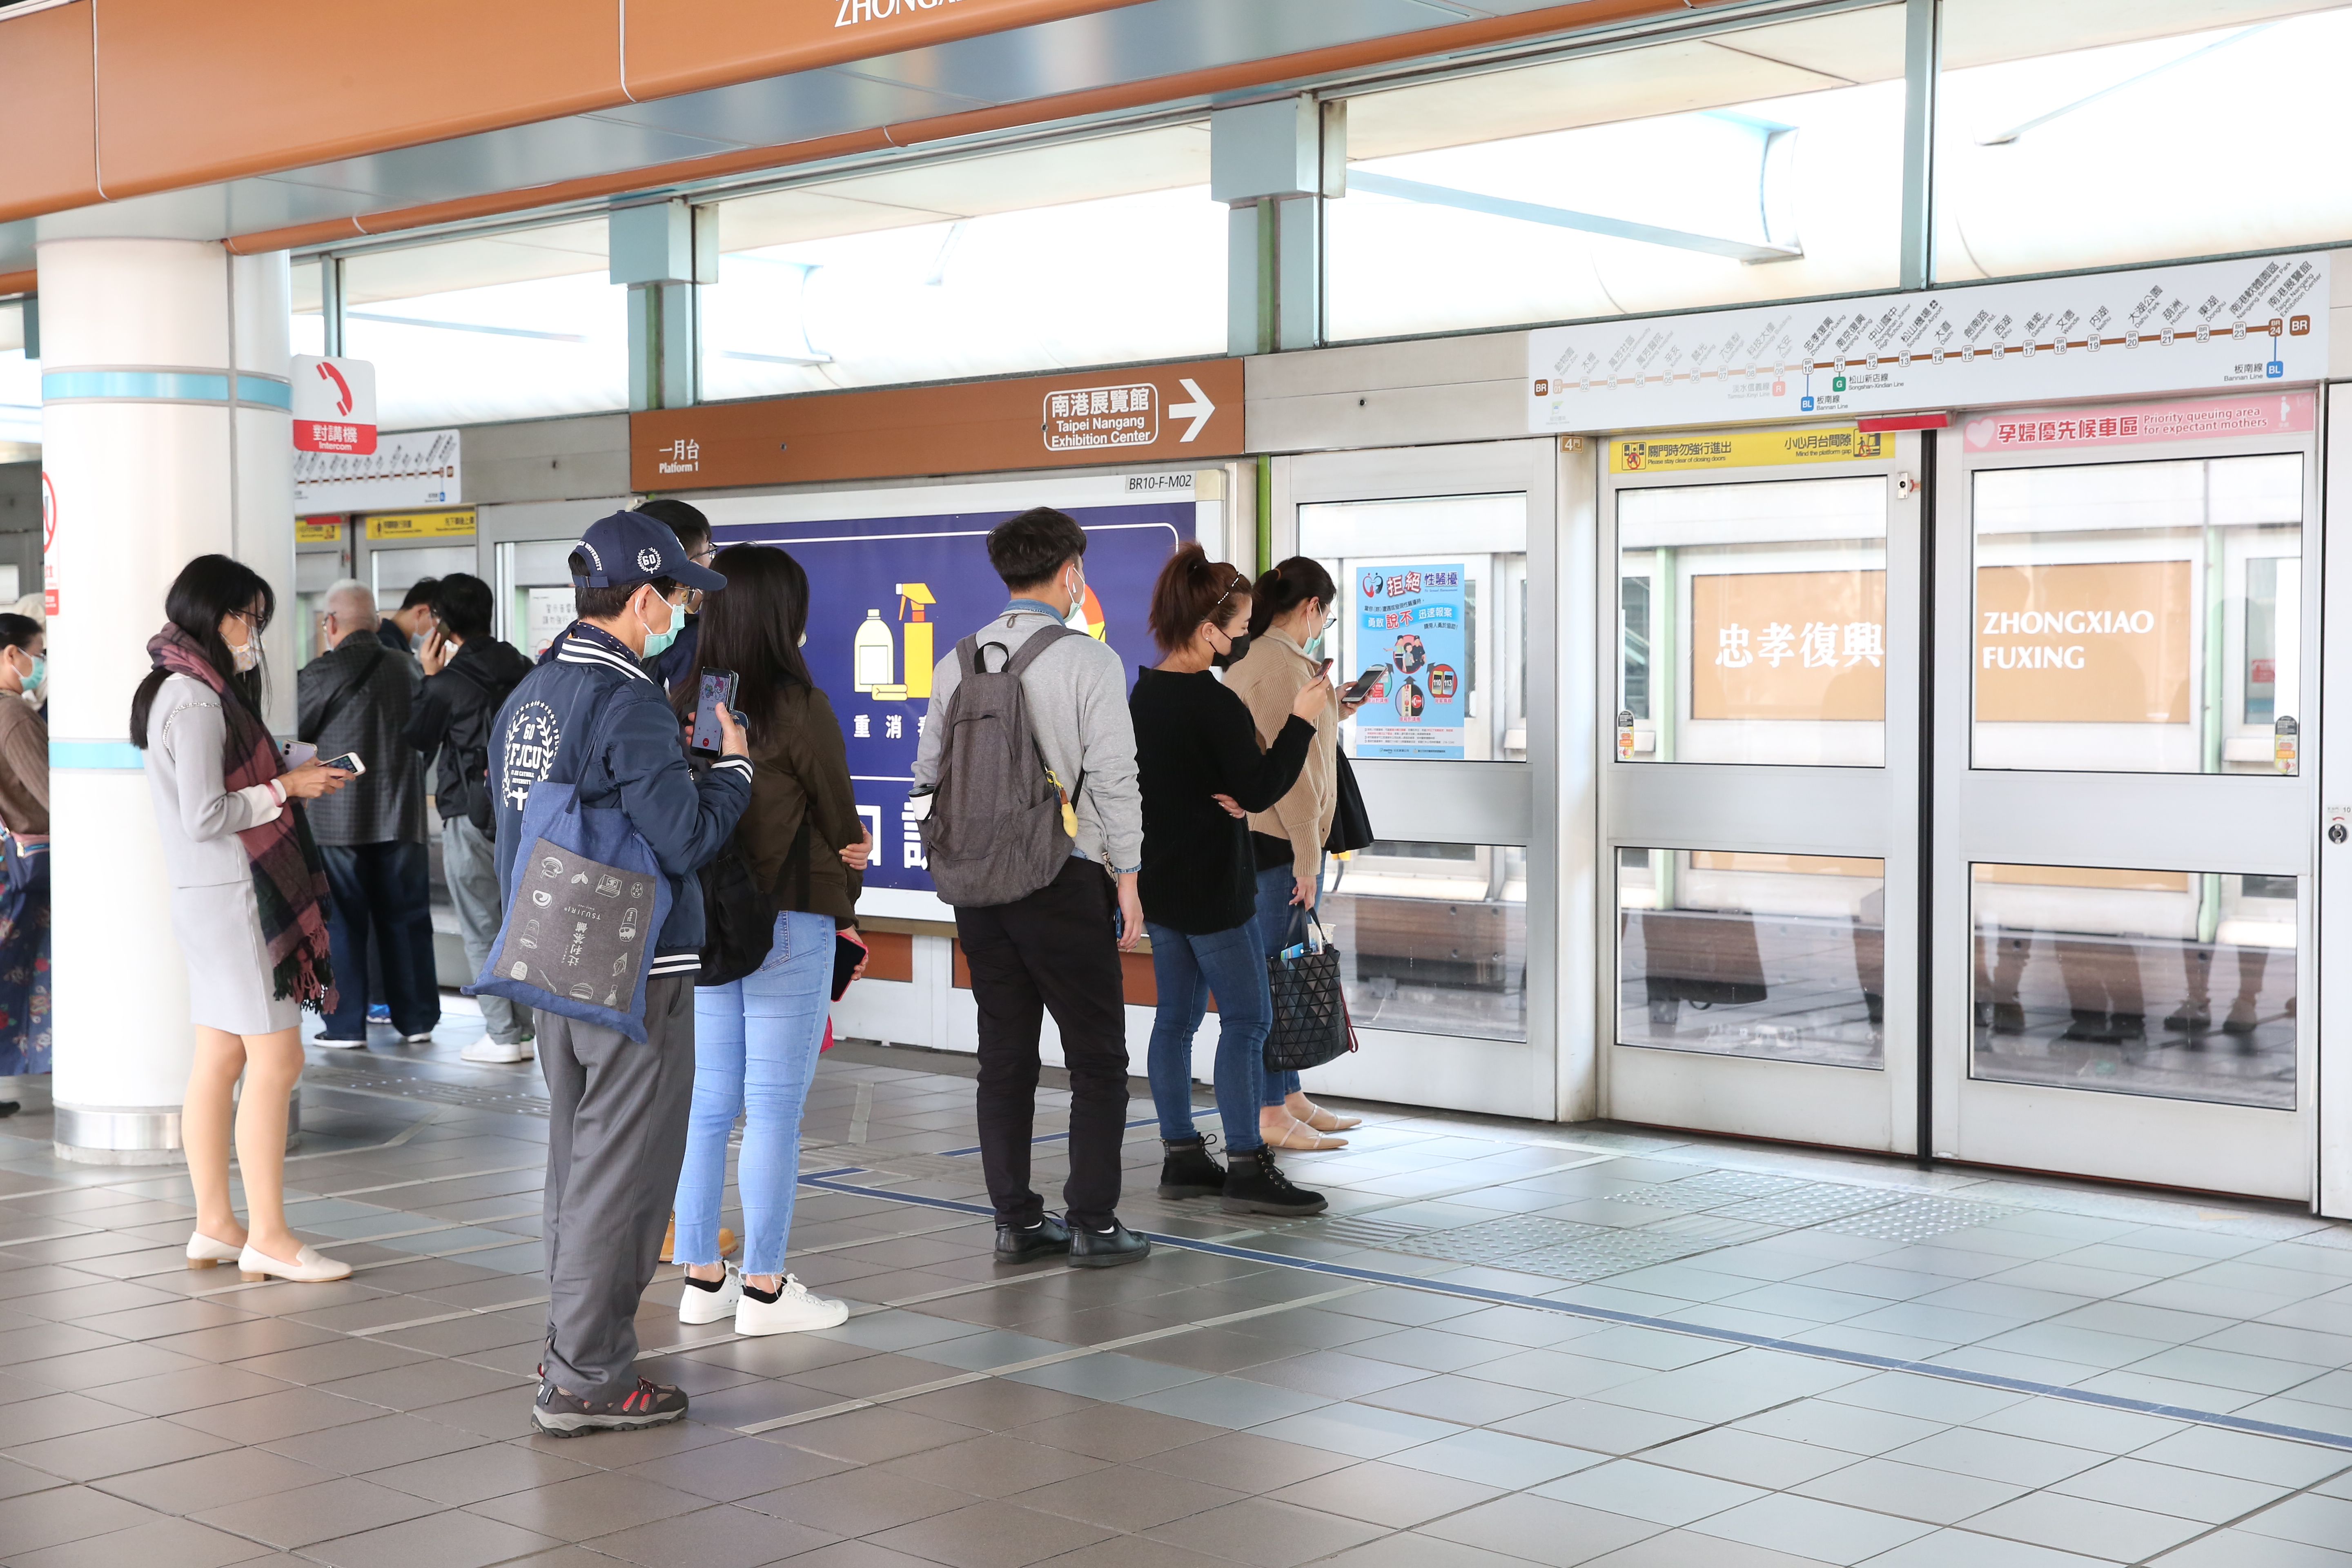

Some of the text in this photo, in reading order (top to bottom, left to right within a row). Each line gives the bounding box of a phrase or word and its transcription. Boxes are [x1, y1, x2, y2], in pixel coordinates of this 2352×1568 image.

[2229, 261, 2279, 315] 南港軟體園區
[2236, 262, 2292, 320] Nangang Software Park
[2267, 261, 2312, 308] 南港展覽館
[2276, 274, 2314, 313] Taipei Nangang
[2280, 273, 2322, 317] Exhibition Center
[2129, 285, 2163, 324] 大湖公園
[2135, 301, 2160, 329] Dahu Park
[2170, 305, 2189, 325] Huzhou
[2197, 295, 2219, 317] 東湖
[2206, 301, 2226, 323] Donghu
[1831, 315, 1846, 331] Fuxing
[1868, 307, 1897, 341] 中山國中
[1874, 304, 1911, 347] Zhongshan Junior
[1900, 307, 1931, 343] 松山機場
[1907, 306, 1944, 348] Songshan Airport
[1964, 310, 1989, 338] 劍南路
[1993, 314, 2012, 336] 西湖
[2056, 309, 2075, 330] 文德
[2062, 316, 2080, 335] Wende
[2089, 305, 2109, 327] 內湖
[2096, 316, 2111, 332] Neihu
[2292, 321, 2307, 330] BR
[1804, 316, 1833, 352] 忠孝復興
[1835, 314, 1865, 348] 南京復興
[1842, 318, 1873, 354] Nanjing Fuxing
[1878, 321, 1903, 350] High School
[1940, 331, 1954, 345] Dazhi
[2000, 328, 2012, 340] Xihu
[1849, 373, 1888, 384] 松山新店線
[2234, 363, 2263, 373] 板南線
[1051, 388, 1149, 418] 南港展覽館
[1817, 395, 1840, 404] 板南線
[1056, 416, 1144, 433] Taipei Nangang
[2144, 408, 2261, 424] Priority queuing area
[2144, 418, 2267, 435] for expectant mothers
[313, 424, 357, 443] 對講機
[1051, 431, 1150, 447] Exhibition Center
[1998, 415, 2139, 444] 孕婦優先候車區
[319, 441, 352, 450] Intercom
[659, 439, 699, 461] 一月台
[1648, 441, 1731, 457] 關門時勿強行進出
[1785, 434, 1851, 450] 小心月台間隙
[659, 461, 698, 473] Platform 1
[1129, 474, 1191, 490] BR10-F-M02
[585, 543, 602, 570] UNIVERSITY
[642, 554, 656, 566] 60
[1387, 571, 1458, 597] 拒絕 性騷擾
[1368, 608, 1452, 629] 勇敢 說不 迅速報案
[1982, 610, 2154, 635] ZHONGXIAO
[1715, 621, 1884, 668] 忠孝復興
[1982, 645, 2085, 669] FUXING
[523, 724, 535, 740] 60
[510, 743, 542, 769] FJCU
